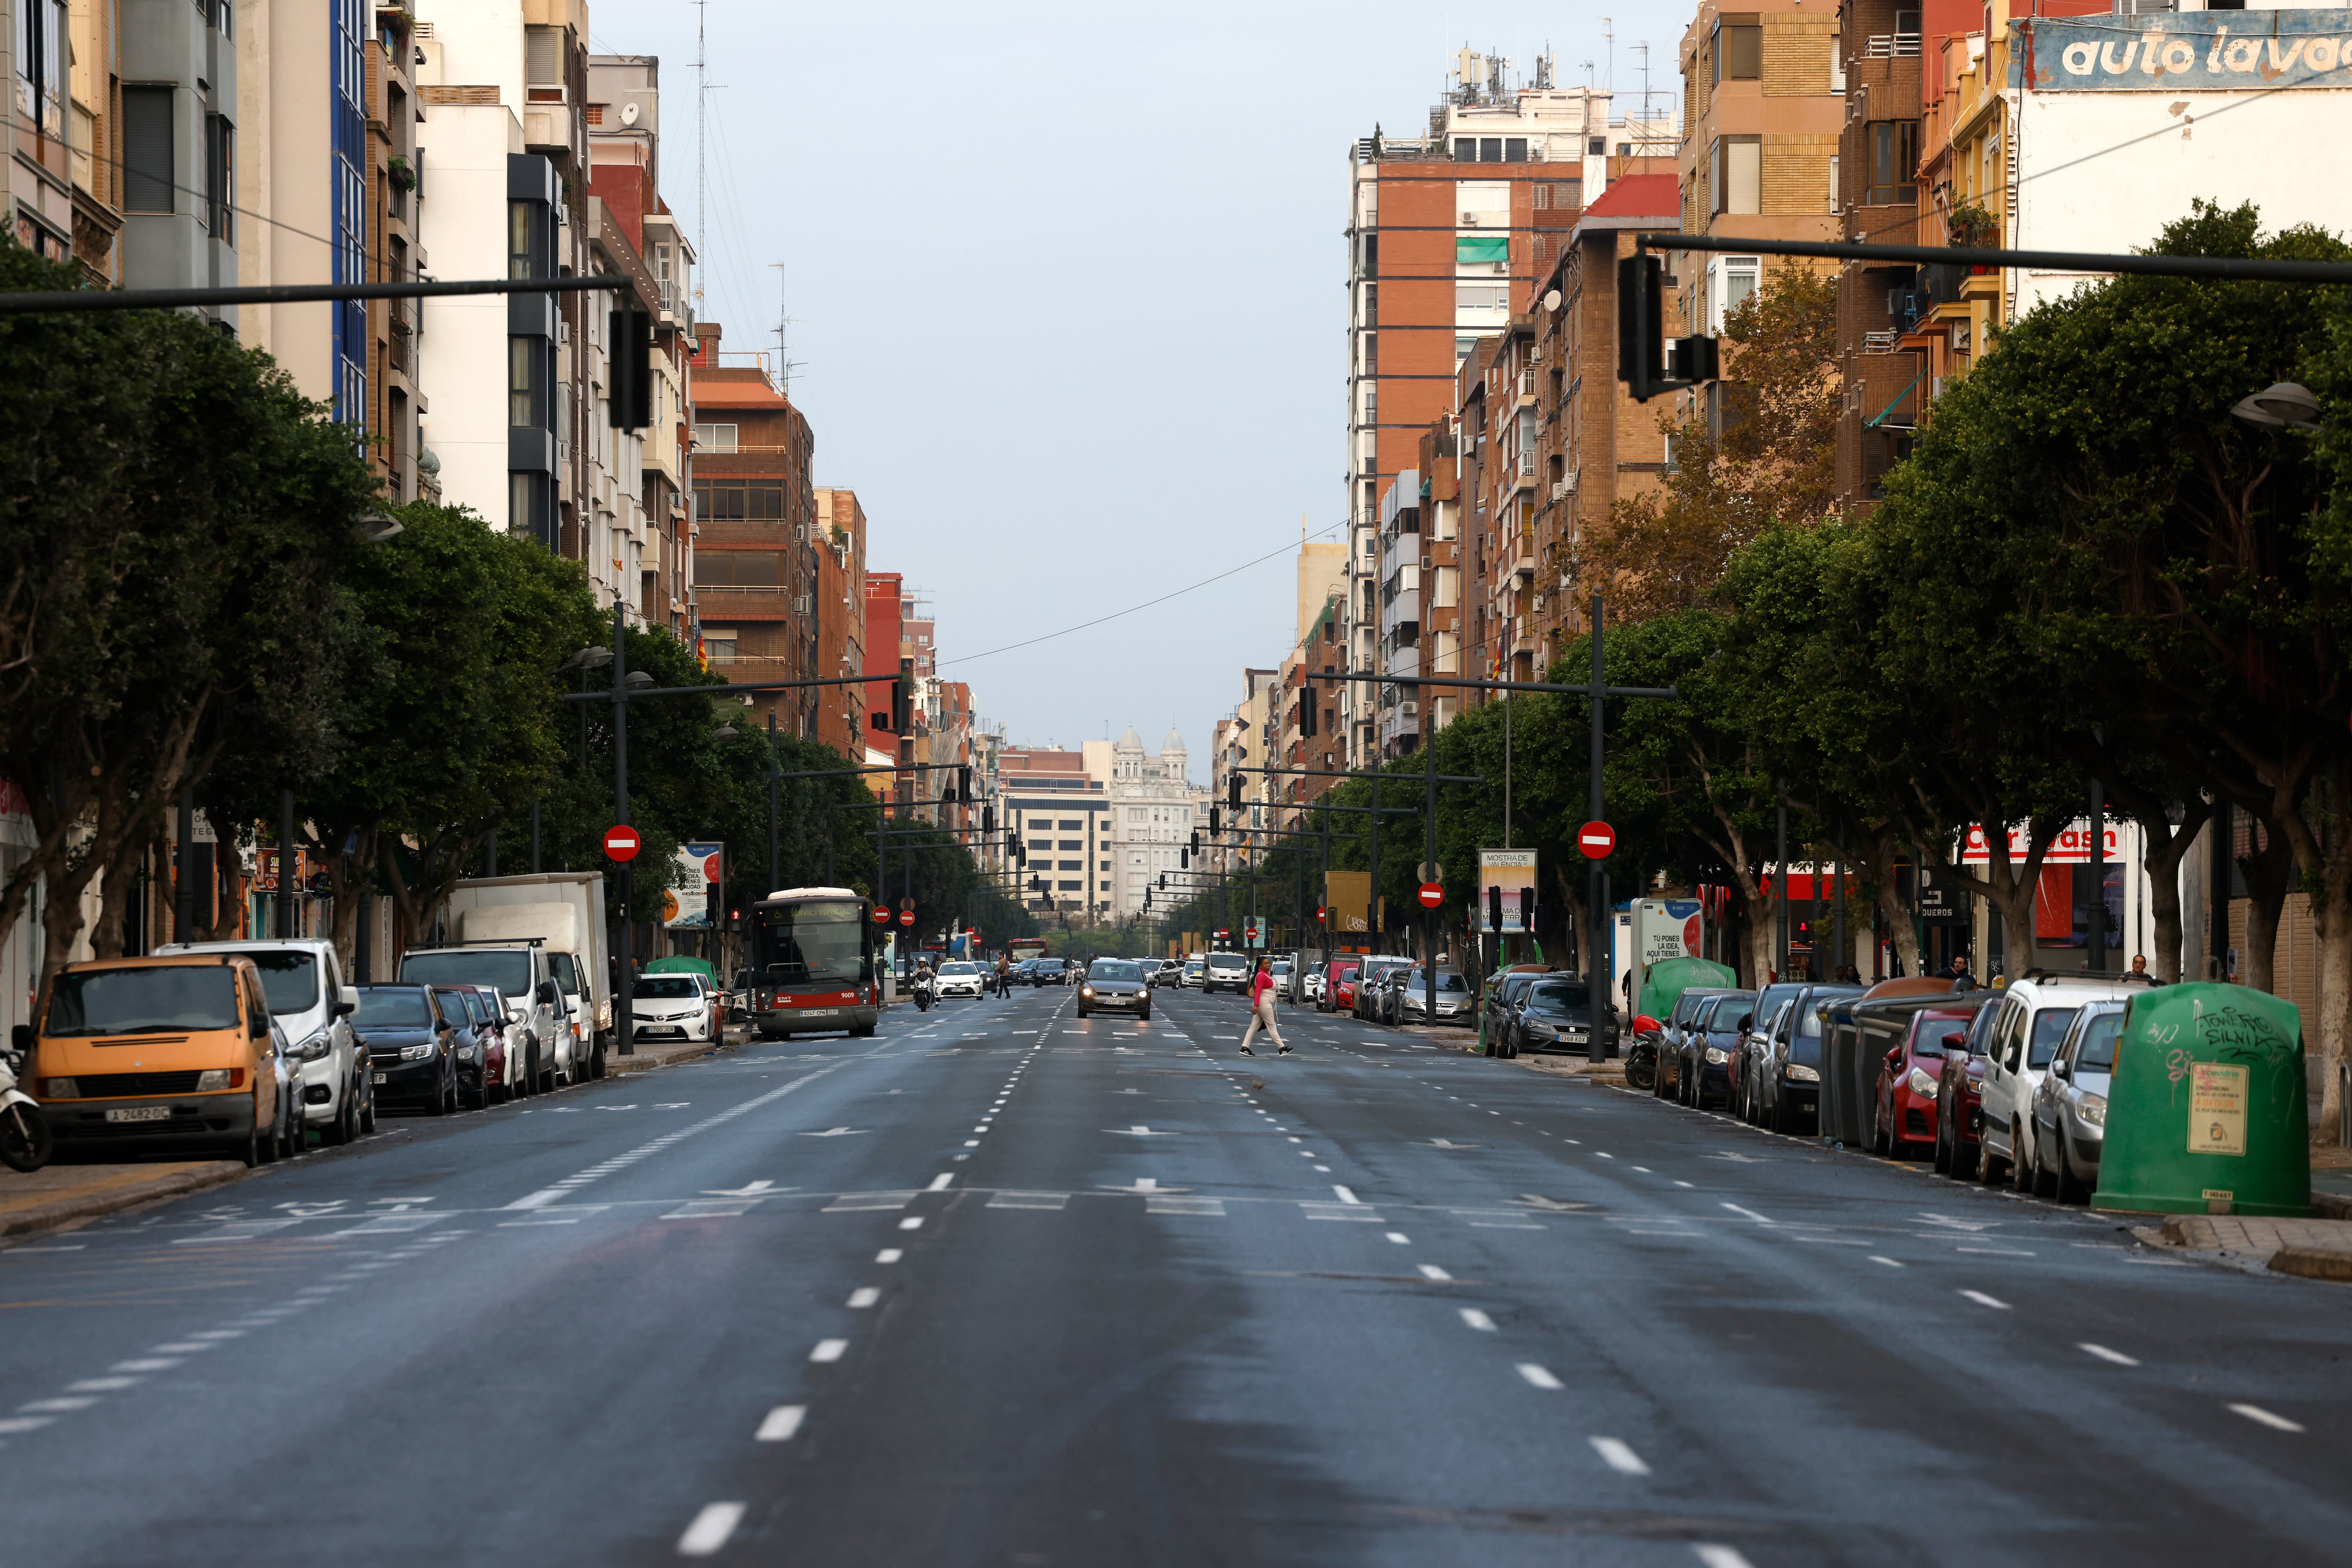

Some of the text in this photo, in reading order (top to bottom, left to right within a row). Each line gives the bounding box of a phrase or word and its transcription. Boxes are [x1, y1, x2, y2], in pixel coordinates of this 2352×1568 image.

[2062, 25, 2352, 75] auto lava
[1966, 825, 2018, 849] Cr
[124, 1109, 151, 1120] 2482
